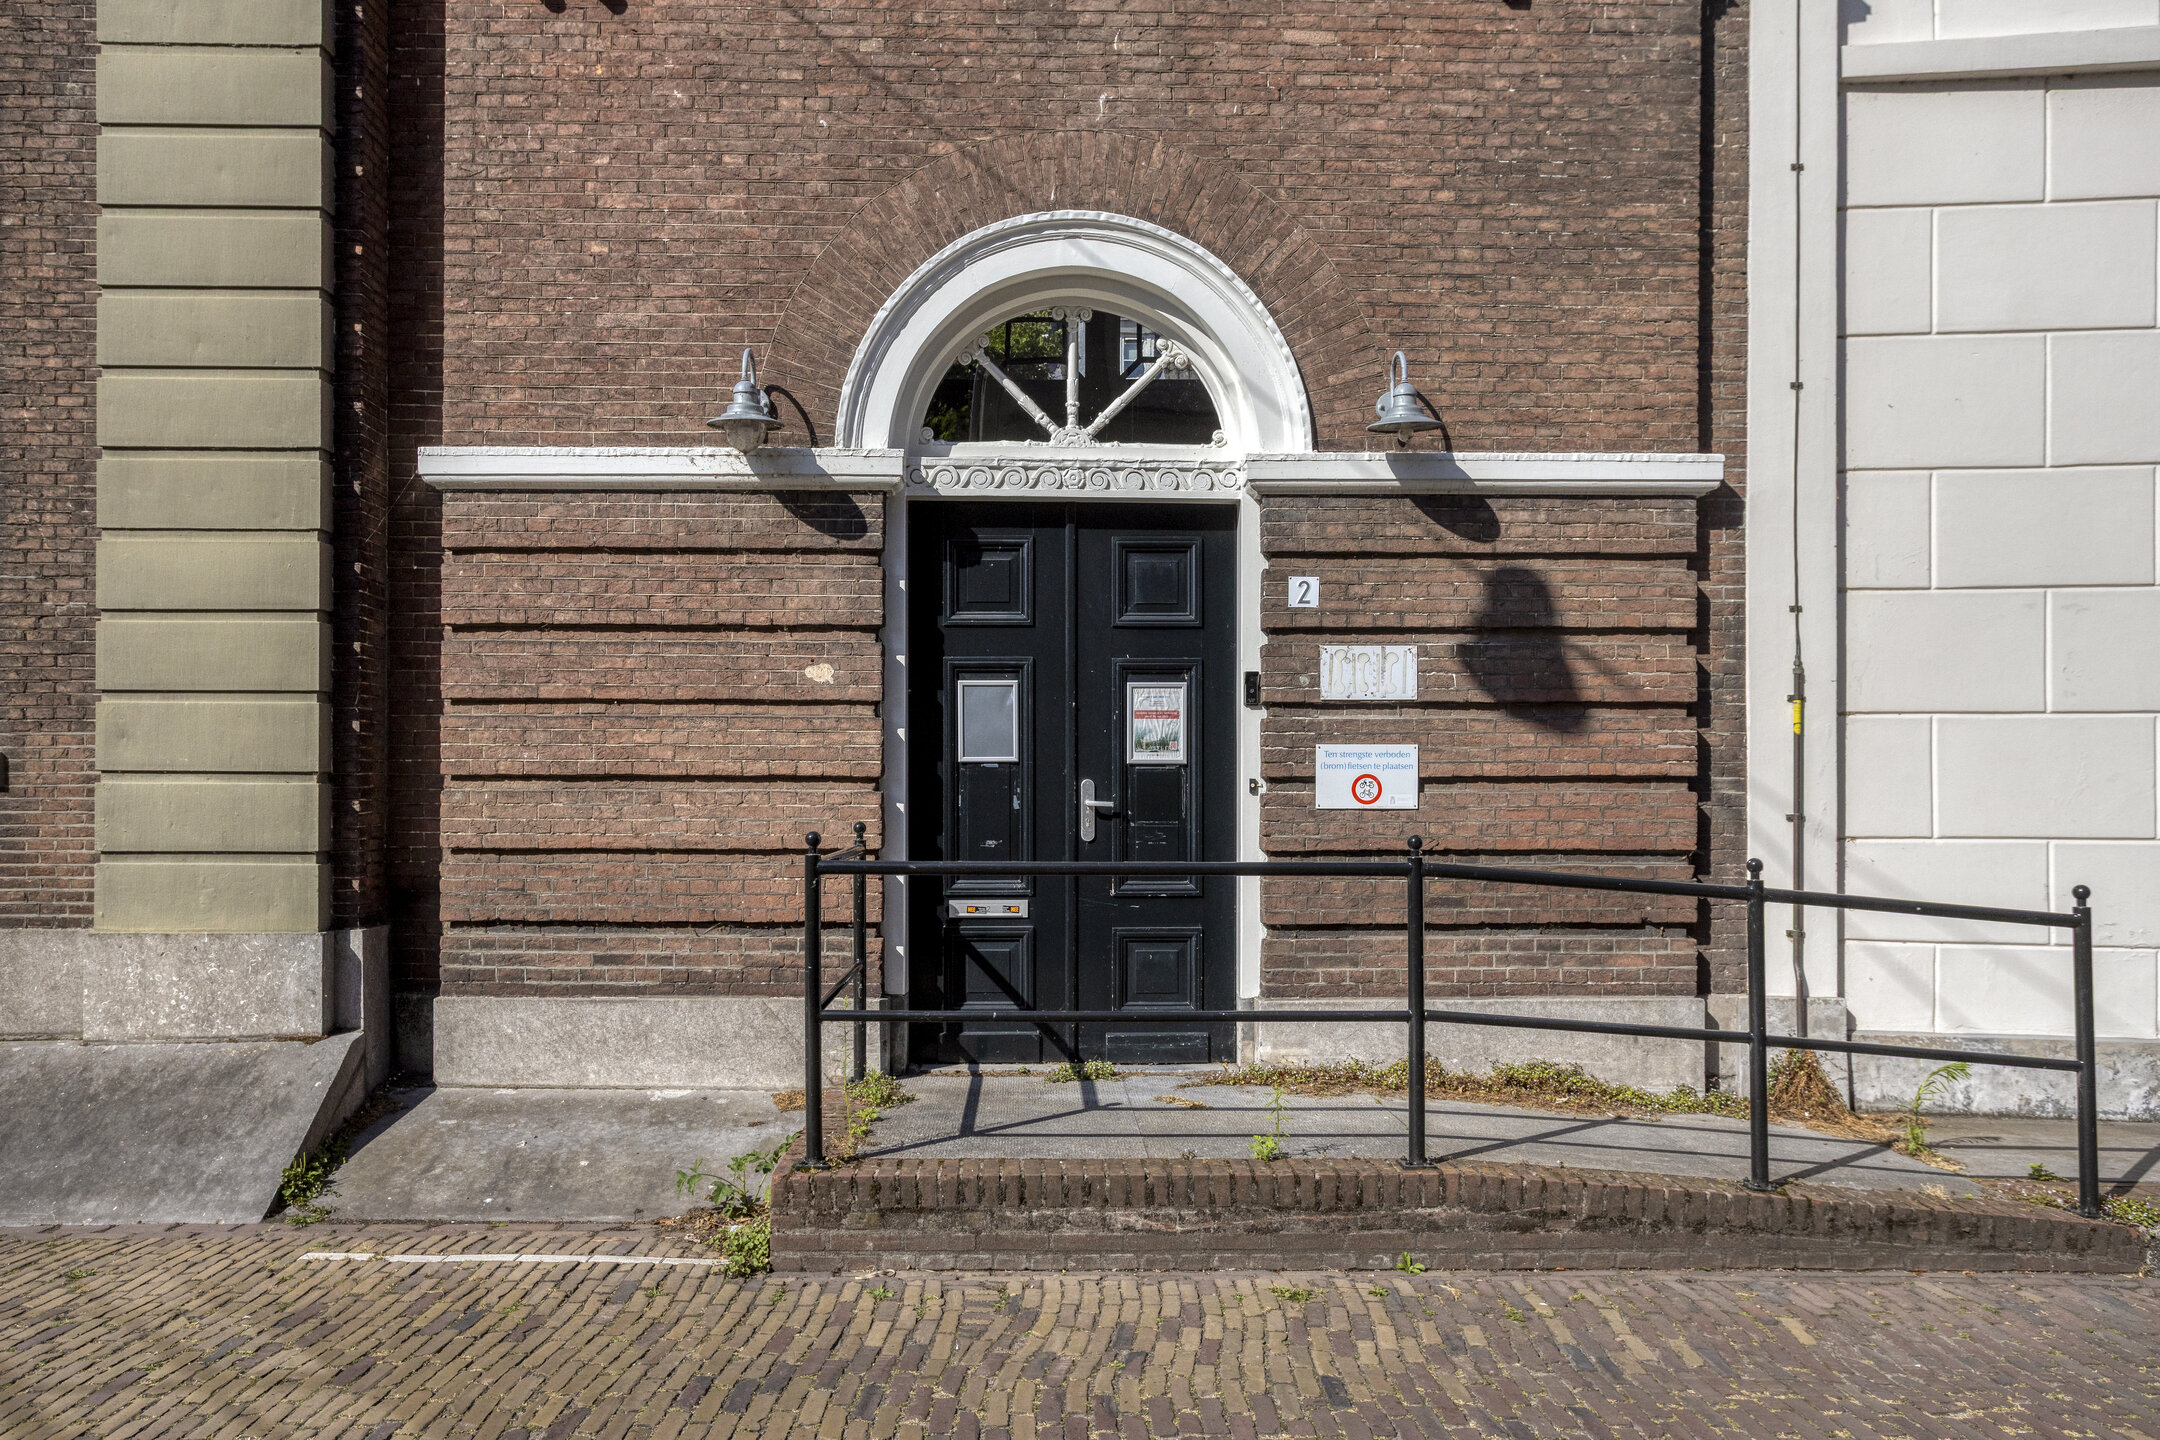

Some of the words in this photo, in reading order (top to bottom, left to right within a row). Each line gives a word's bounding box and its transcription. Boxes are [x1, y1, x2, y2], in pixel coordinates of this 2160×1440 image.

[1297, 580, 1311, 604] 2
[1339, 751, 1373, 760] strengste
[1375, 750, 1411, 758] verboden
[1382, 762, 1414, 771] plaatsen
